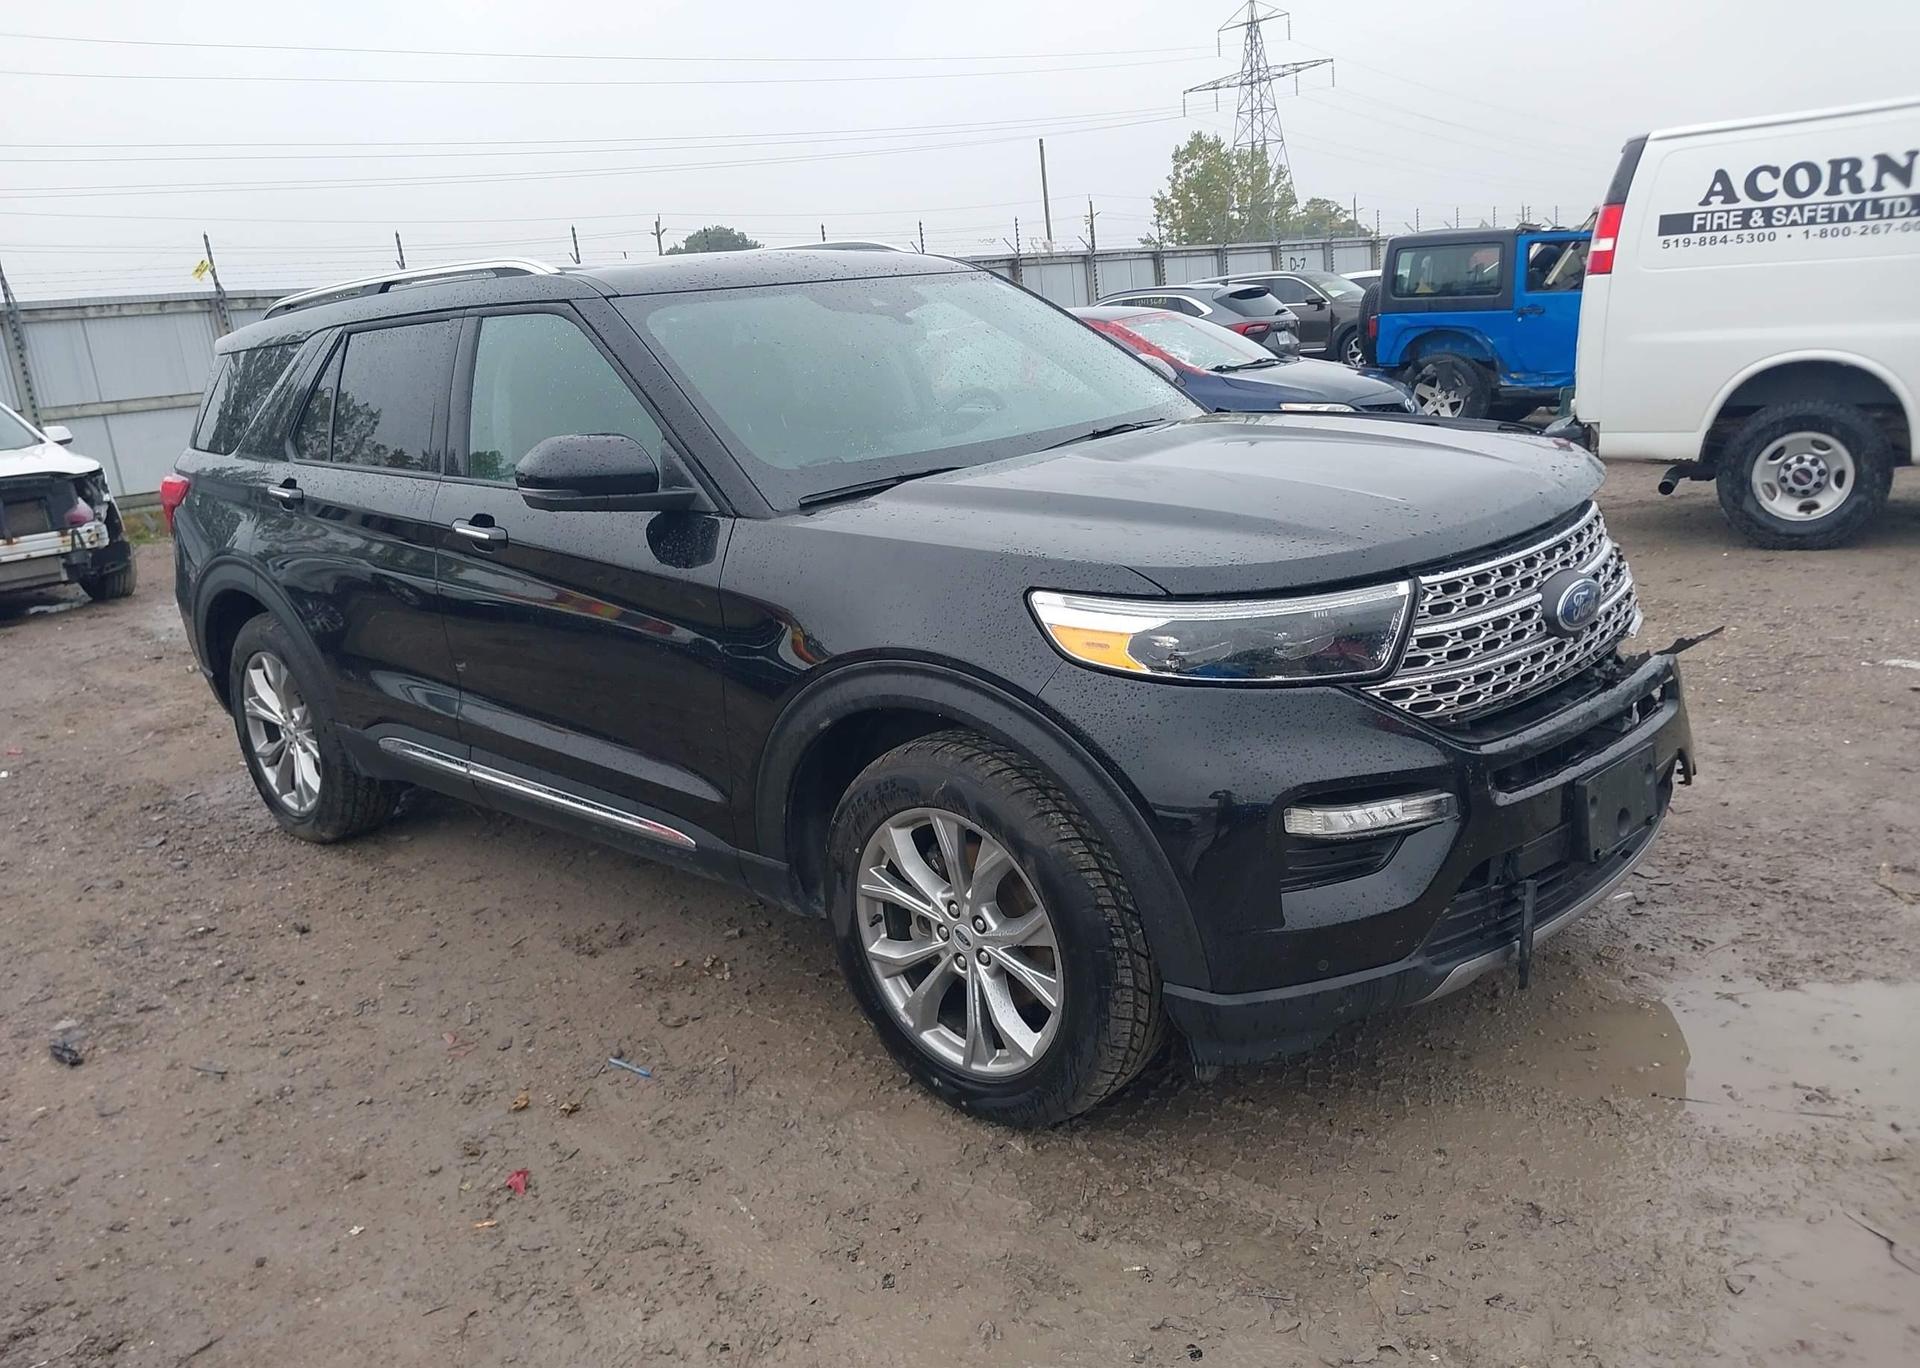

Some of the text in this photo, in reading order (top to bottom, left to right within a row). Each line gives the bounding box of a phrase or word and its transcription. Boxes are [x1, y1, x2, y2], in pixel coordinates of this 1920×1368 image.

[1698, 150, 1919, 206] ACORN
[1692, 197, 1919, 232] FIRE & SAFETY LTD.
[1661, 231, 1777, 250] 519-884-5300
